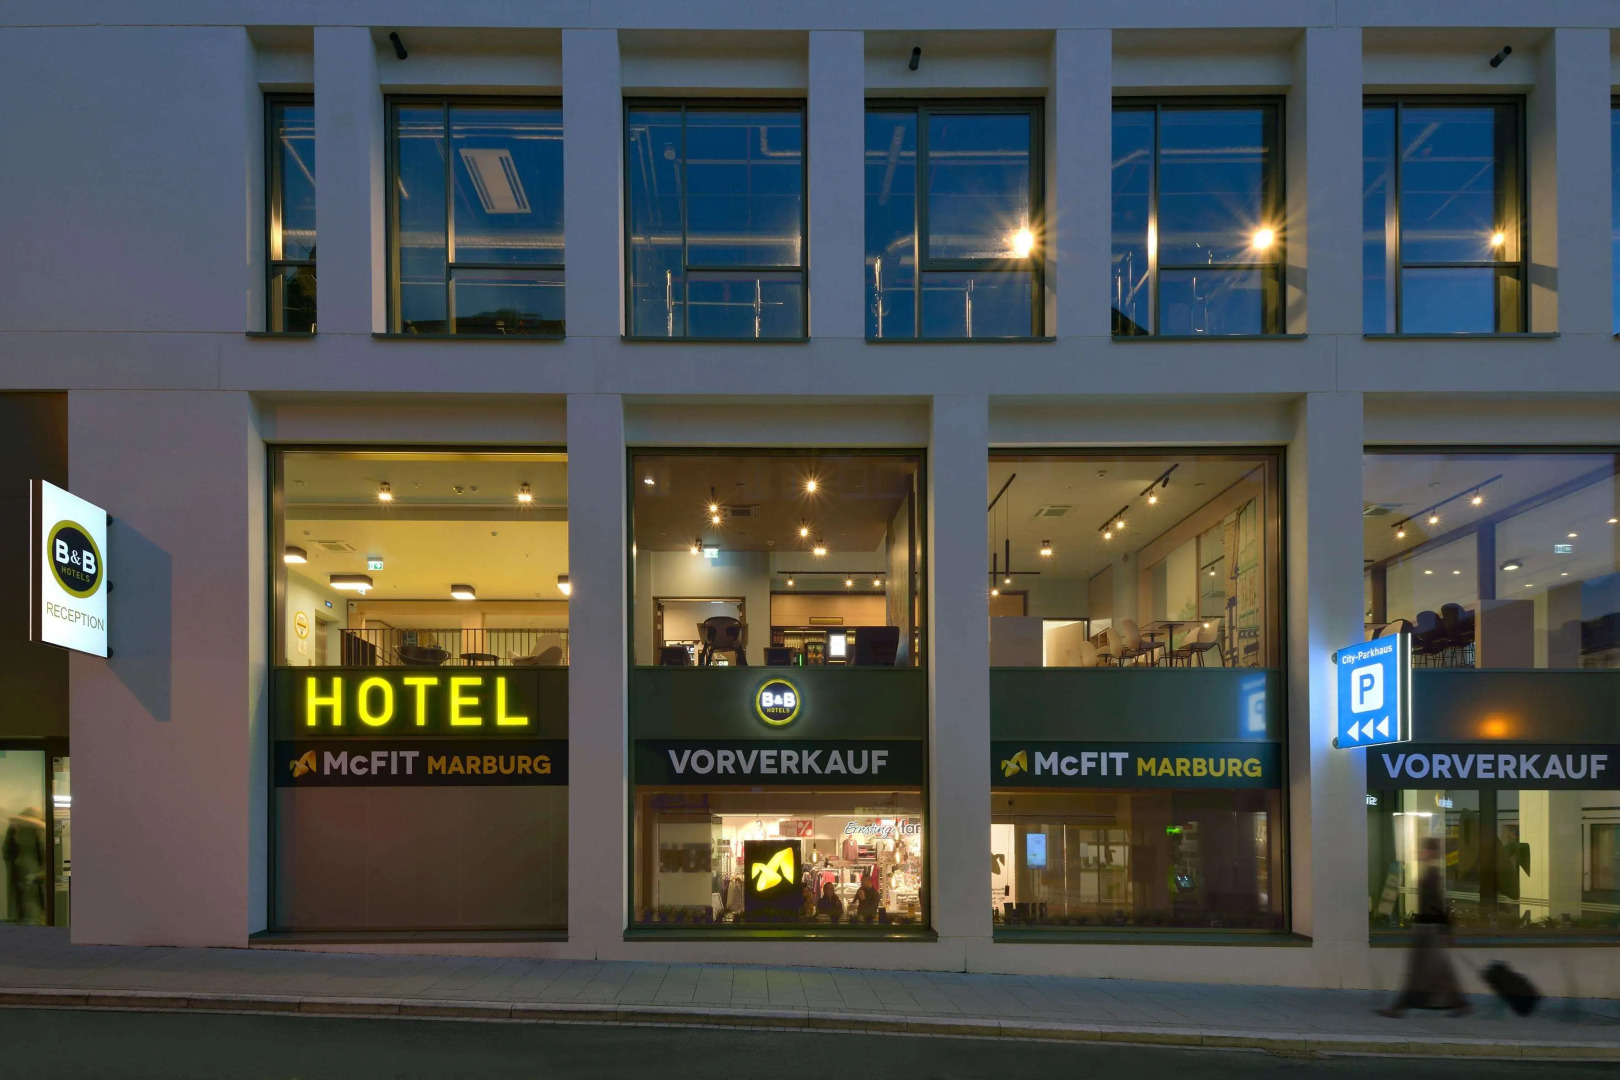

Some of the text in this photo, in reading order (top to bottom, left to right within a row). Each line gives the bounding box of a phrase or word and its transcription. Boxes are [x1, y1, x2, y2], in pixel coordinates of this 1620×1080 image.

[55, 538, 97, 575] B&B
[61, 565, 90, 583] HOTELS
[46, 601, 104, 631] RECEPTION
[1341, 645, 1393, 665] City-Parkhaus
[306, 677, 529, 726] HOTEL
[762, 692, 796, 707] B&B
[1359, 673, 1375, 705] P
[324, 751, 552, 776] McFIT MARBURG
[668, 749, 889, 775] VORVERKAUF
[1034, 751, 1263, 777] McFIT MARBURG
[1382, 753, 1608, 780] VORVERKAUF
